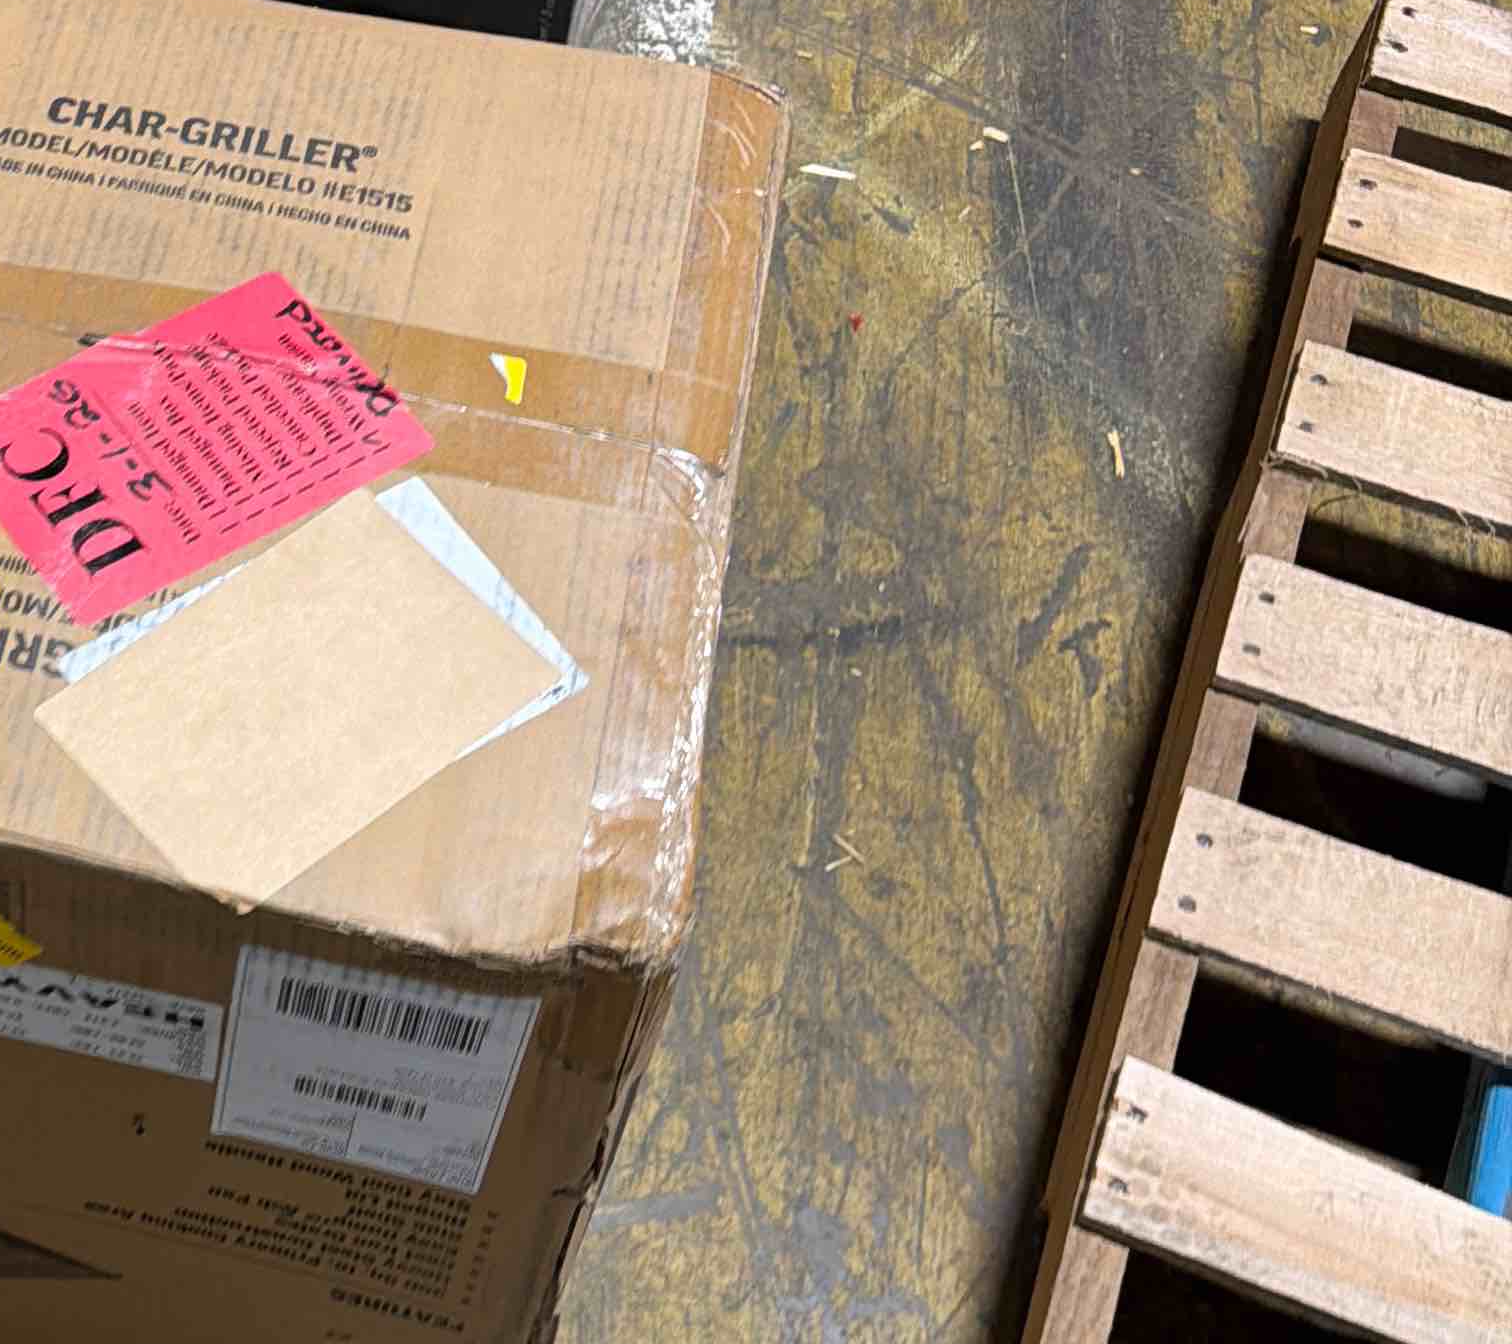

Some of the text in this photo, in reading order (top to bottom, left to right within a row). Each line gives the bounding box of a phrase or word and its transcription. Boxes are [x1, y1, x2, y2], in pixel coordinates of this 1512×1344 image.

[27, 160, 45, 176] IN
[45, 164, 96, 186] CHINA
[188, 188, 212, 204] EN
[214, 192, 266, 215] CHINA
[276, 203, 333, 227] HECHO
[333, 214, 359, 232] EN
[359, 218, 412, 241] CHINA
[321, 181, 414, 215] #E1515
[126, 400, 217, 511] Damaged Item
[159, 394, 242, 498] Damaged Box
[217, 422, 262, 484] Missing
[233, 404, 292, 472] Rejected
[252, 383, 317, 457] Cancelled
[163, 499, 201, 545] Date:
